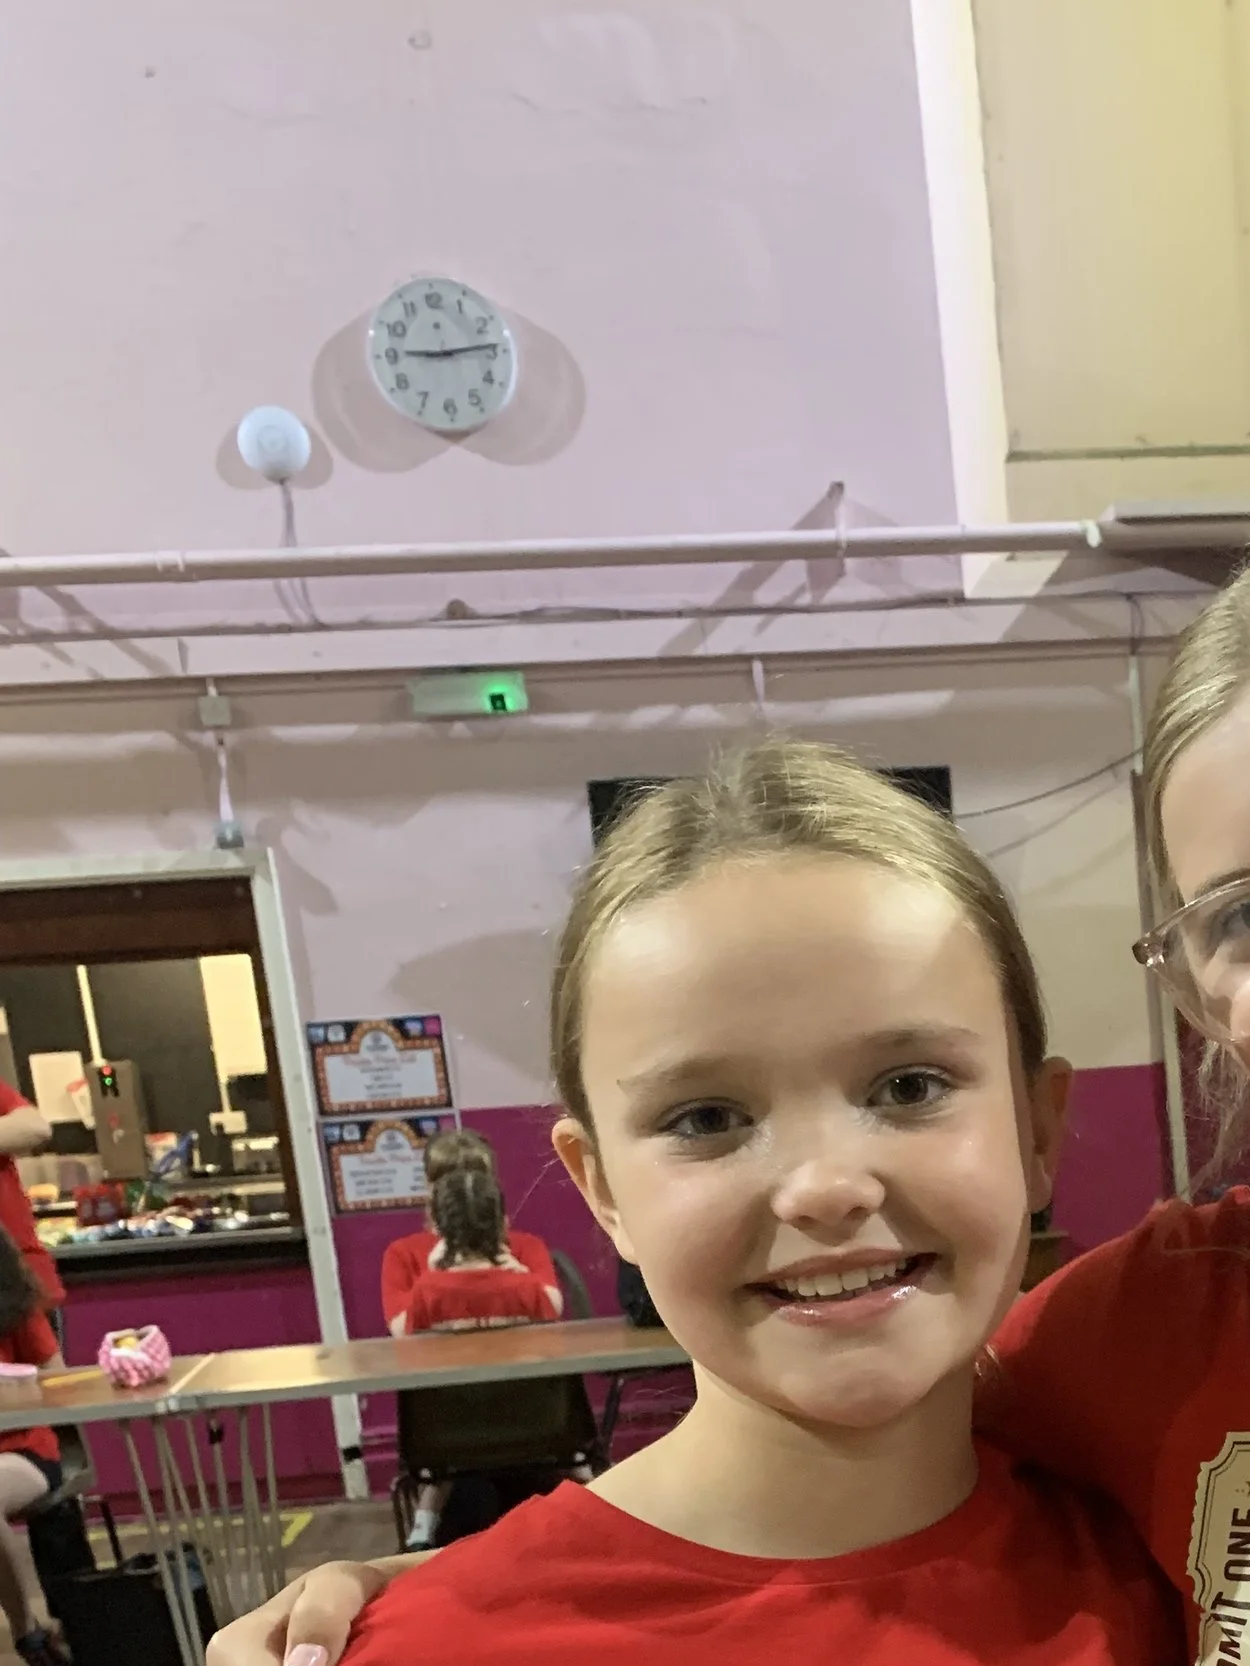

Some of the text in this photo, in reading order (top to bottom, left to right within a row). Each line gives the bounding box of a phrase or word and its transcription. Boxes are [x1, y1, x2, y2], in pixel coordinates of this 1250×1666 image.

[386, 320, 407, 338] 10
[475, 316, 490, 335] 2
[384, 347, 398, 366] 9
[395, 372, 410, 391] 8
[482, 369, 495, 386] 4
[417, 391, 429, 409] 7
[467, 388, 482, 407] 5
[443, 398, 457, 416] 6
